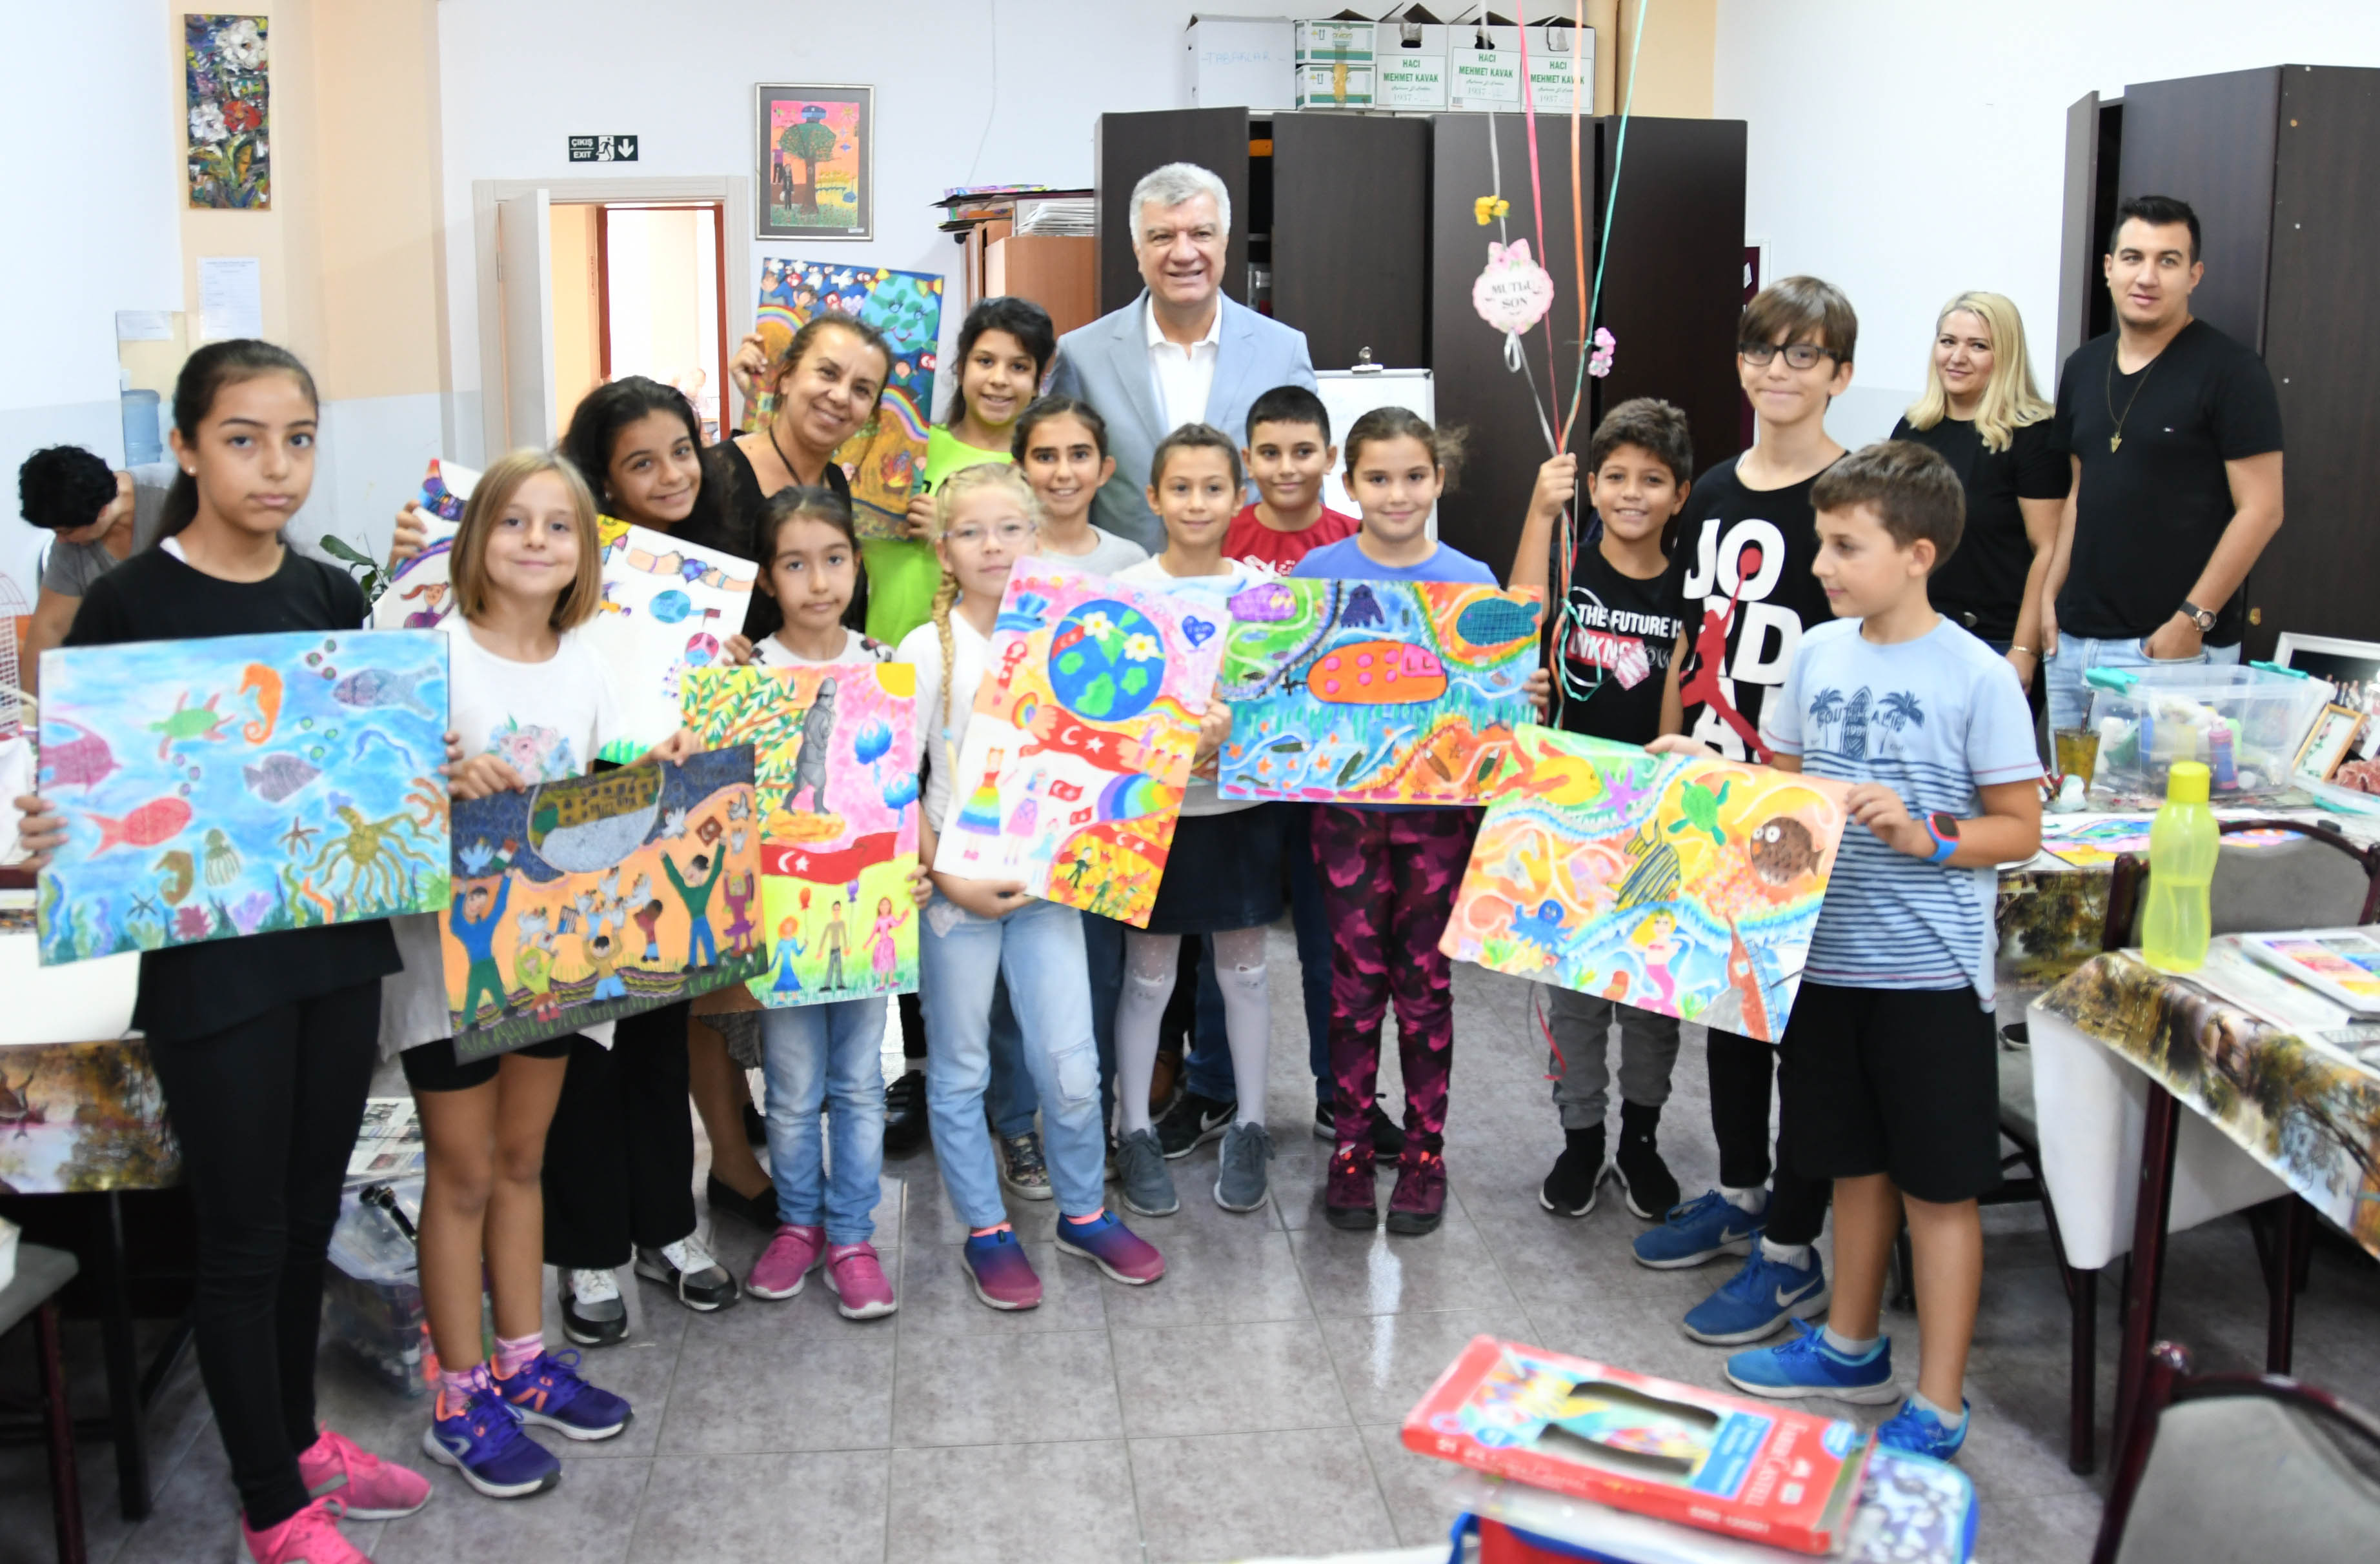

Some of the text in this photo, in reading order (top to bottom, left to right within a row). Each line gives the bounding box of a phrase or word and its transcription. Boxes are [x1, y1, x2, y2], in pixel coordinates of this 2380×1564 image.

[1478, 53, 1496, 62] HACI
[1402, 59, 1420, 68] HACI
[1549, 61, 1567, 70] HACI
[1383, 72, 1439, 83] MEHMET KAVAK
[1459, 66, 1513, 78] MEHMET KAVAK
[1530, 74, 1585, 85] MEHMET KAVK
[1577, 603, 1608, 628] THE
[1611, 609, 1670, 638] FUTURE
